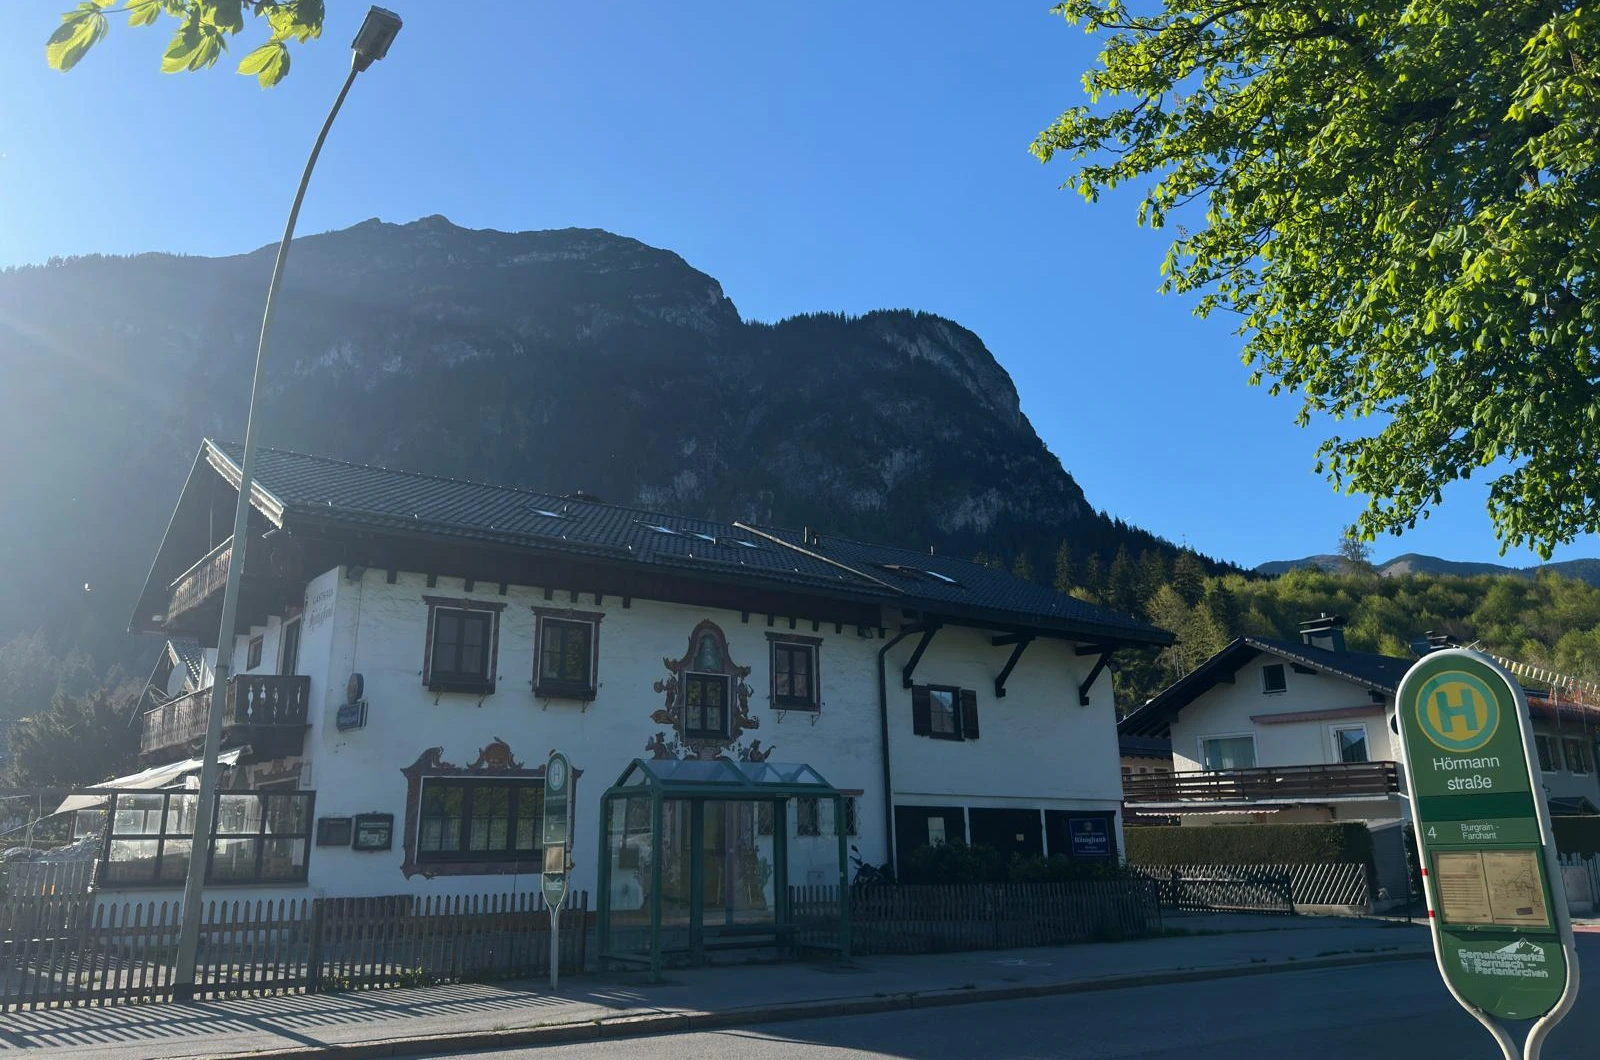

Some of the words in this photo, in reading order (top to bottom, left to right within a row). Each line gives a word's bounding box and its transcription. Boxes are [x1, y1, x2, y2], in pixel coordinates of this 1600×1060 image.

[1435, 688, 1478, 732] H
[1432, 756, 1500, 771] Hörmann
[1447, 774, 1492, 790] straße
[1427, 825, 1438, 839] 4
[1460, 822, 1494, 833] Burgrain
[1462, 831, 1497, 840] Farchant
[1458, 948, 1546, 963] Gemeindewerke
[1473, 958, 1525, 969] Garmisch
[1475, 967, 1549, 978] Partenkirchen
